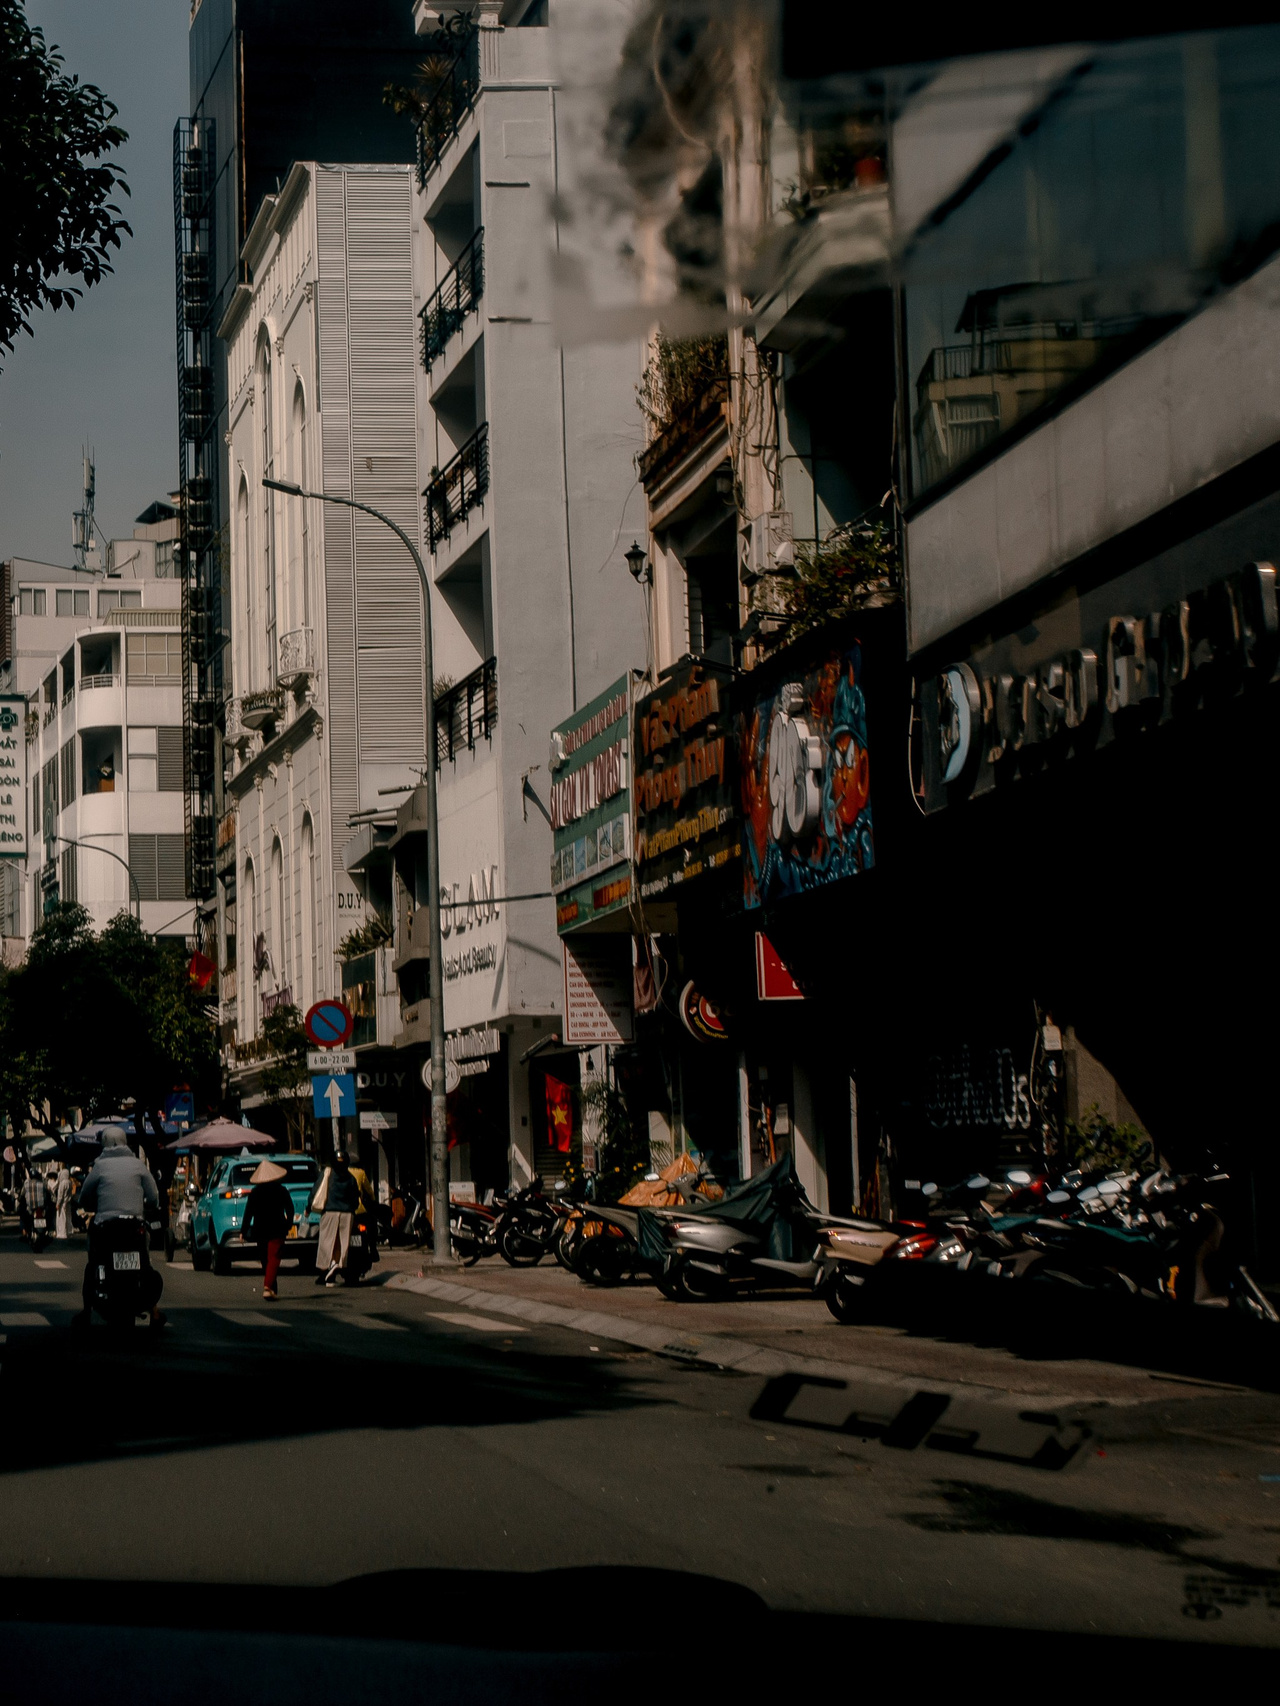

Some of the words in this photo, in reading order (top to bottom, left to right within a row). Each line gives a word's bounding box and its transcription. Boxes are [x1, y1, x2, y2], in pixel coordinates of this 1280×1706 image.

[0, 793, 14, 806] LÊ
[338, 893, 363, 909] D.U.Y
[356, 1071, 407, 1089] D.U.Y
